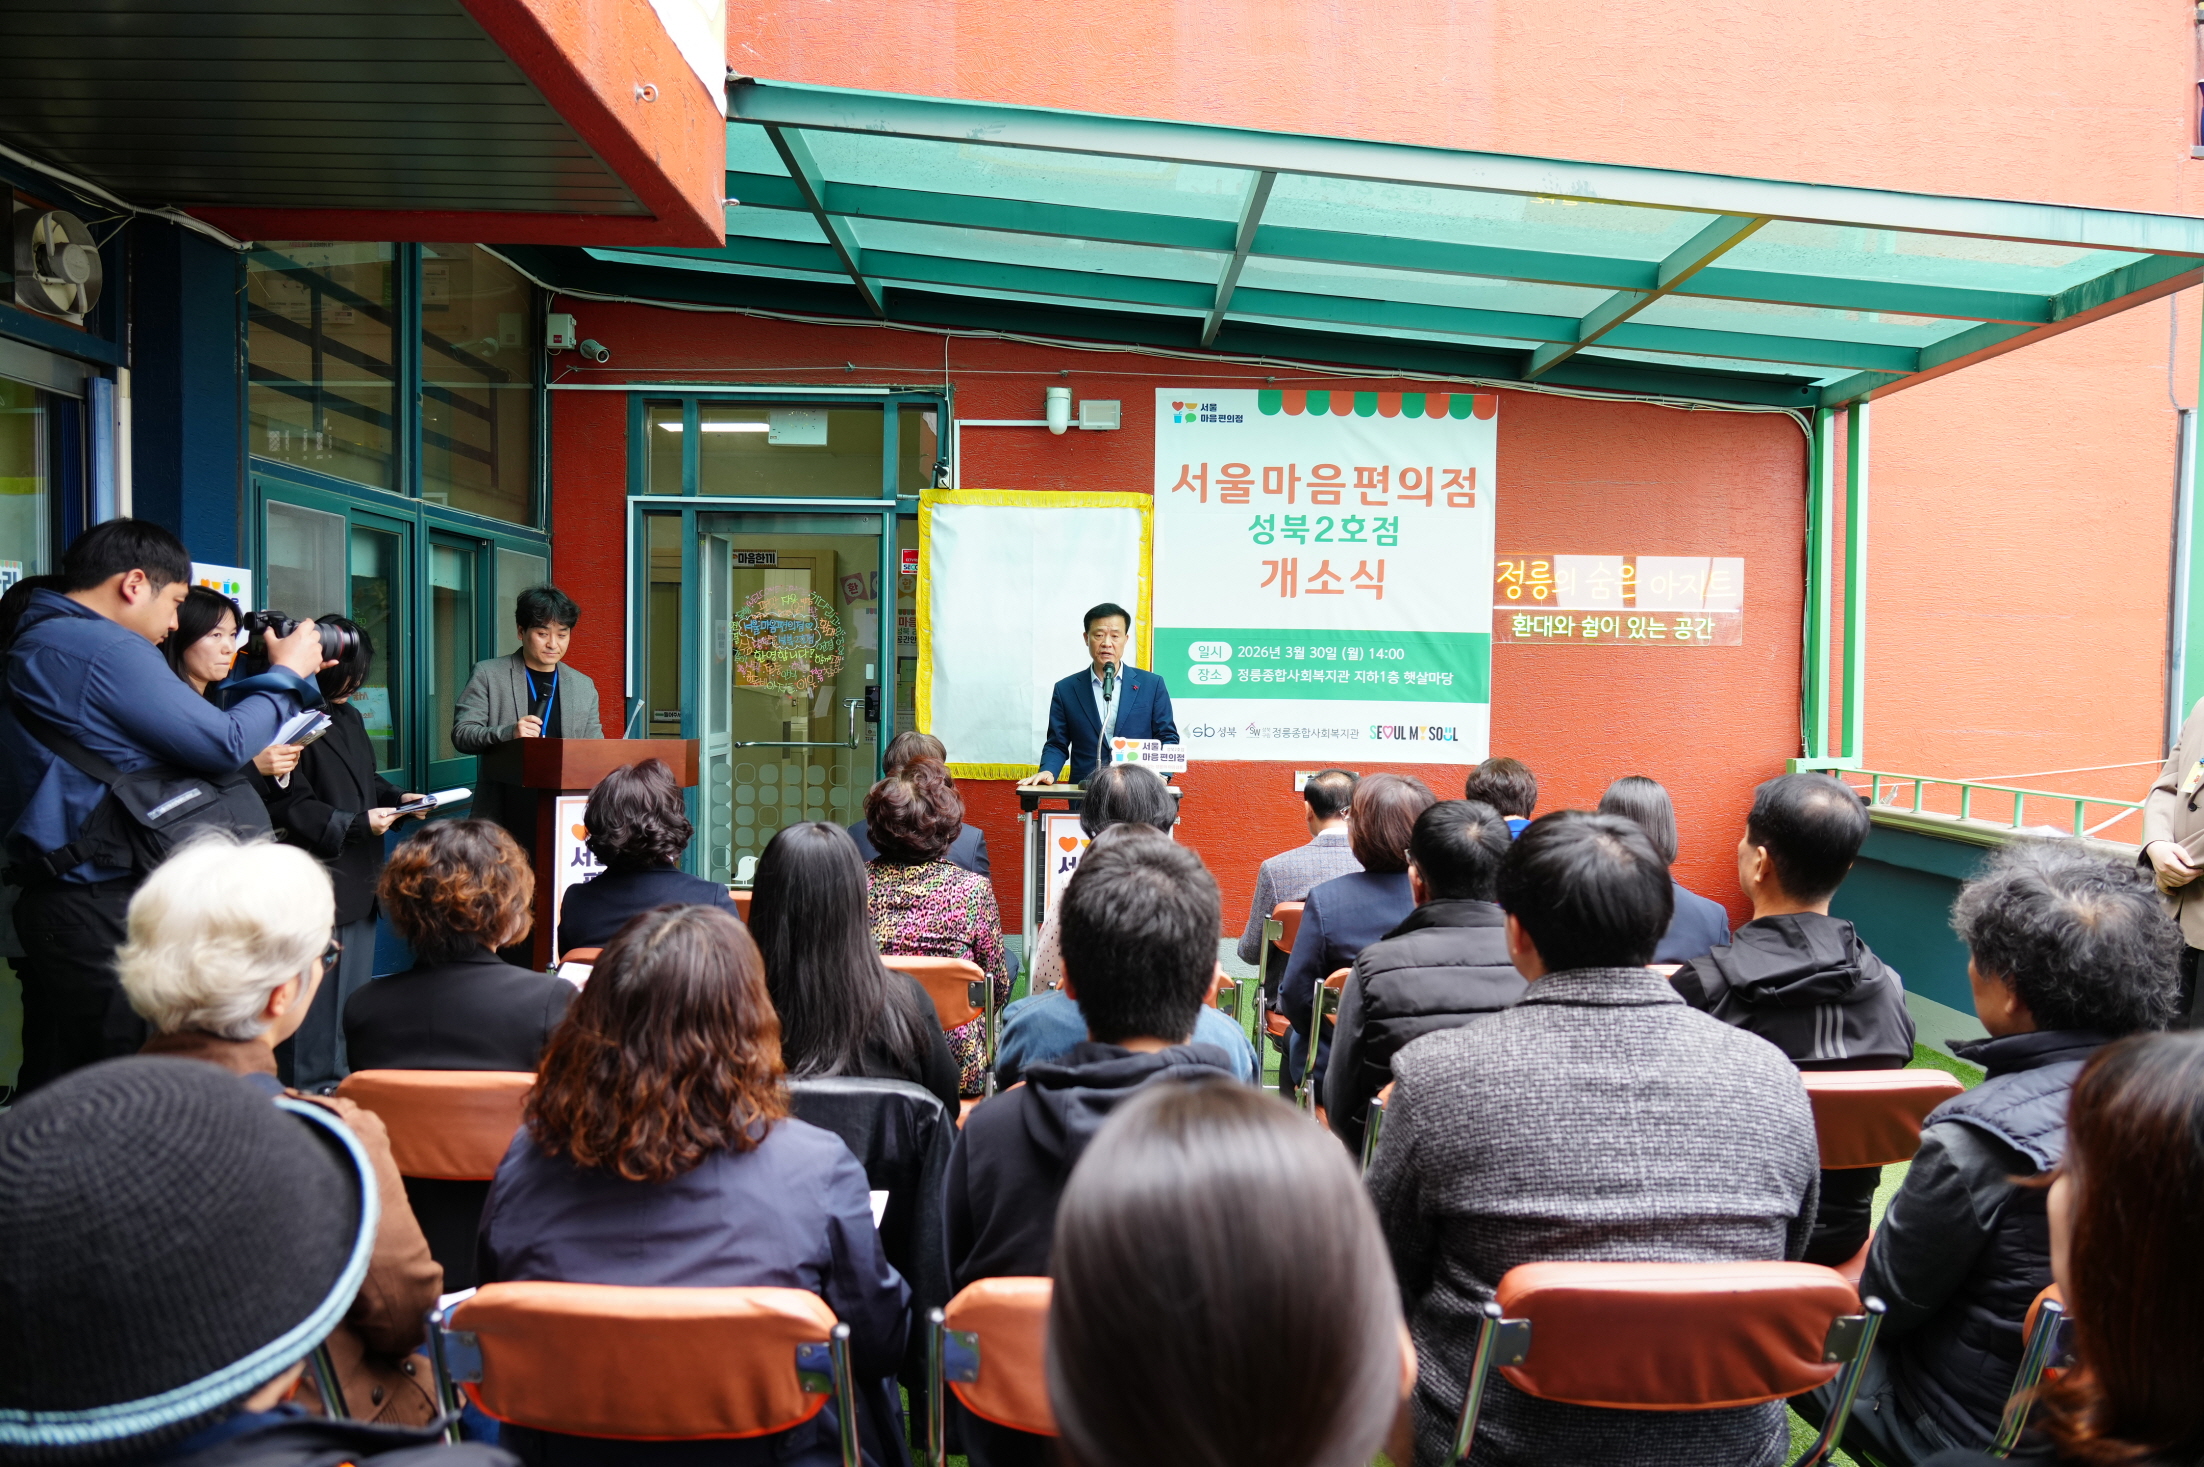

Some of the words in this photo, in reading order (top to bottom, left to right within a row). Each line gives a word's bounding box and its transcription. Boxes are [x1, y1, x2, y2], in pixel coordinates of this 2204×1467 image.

[1200, 403, 1217, 412] 서울
[1171, 462, 1477, 509] 서울마음편의점
[1248, 514, 1399, 547] 성북2호점
[1260, 557, 1385, 600] 개소식
[1497, 560, 1575, 600] 정릉의
[1585, 562, 1641, 600] 숨은
[1650, 570, 1737, 600] 아지트
[847, 582, 859, 594] 환
[743, 620, 805, 636] 서울마음편의점
[1512, 613, 1576, 637] 환대와
[1581, 615, 1620, 638] 쉼이
[1627, 616, 1667, 639] 있는
[1673, 617, 1716, 640] 공간
[1198, 644, 1222, 659] 일시
[1238, 645, 1281, 660] 2026년
[1285, 646, 1305, 660] 3월
[1309, 646, 1337, 660] 30일
[1341, 647, 1364, 661] (월)
[1368, 648, 1405, 660] 14:00
[1198, 667, 1222, 681] 장소
[1237, 668, 1350, 684] 정릉종합사회복지관
[1354, 669, 1400, 685] 지하1층
[1403, 671, 1454, 686] 햇살마당
[1192, 723, 1215, 738] sb
[1217, 726, 1237, 739] 성북
[1272, 727, 1360, 740] 정릉종합사회복지관
[1142, 742, 1159, 751] 서울
[1142, 752, 1185, 763] 마음편의점
[571, 847, 607, 867] 서
